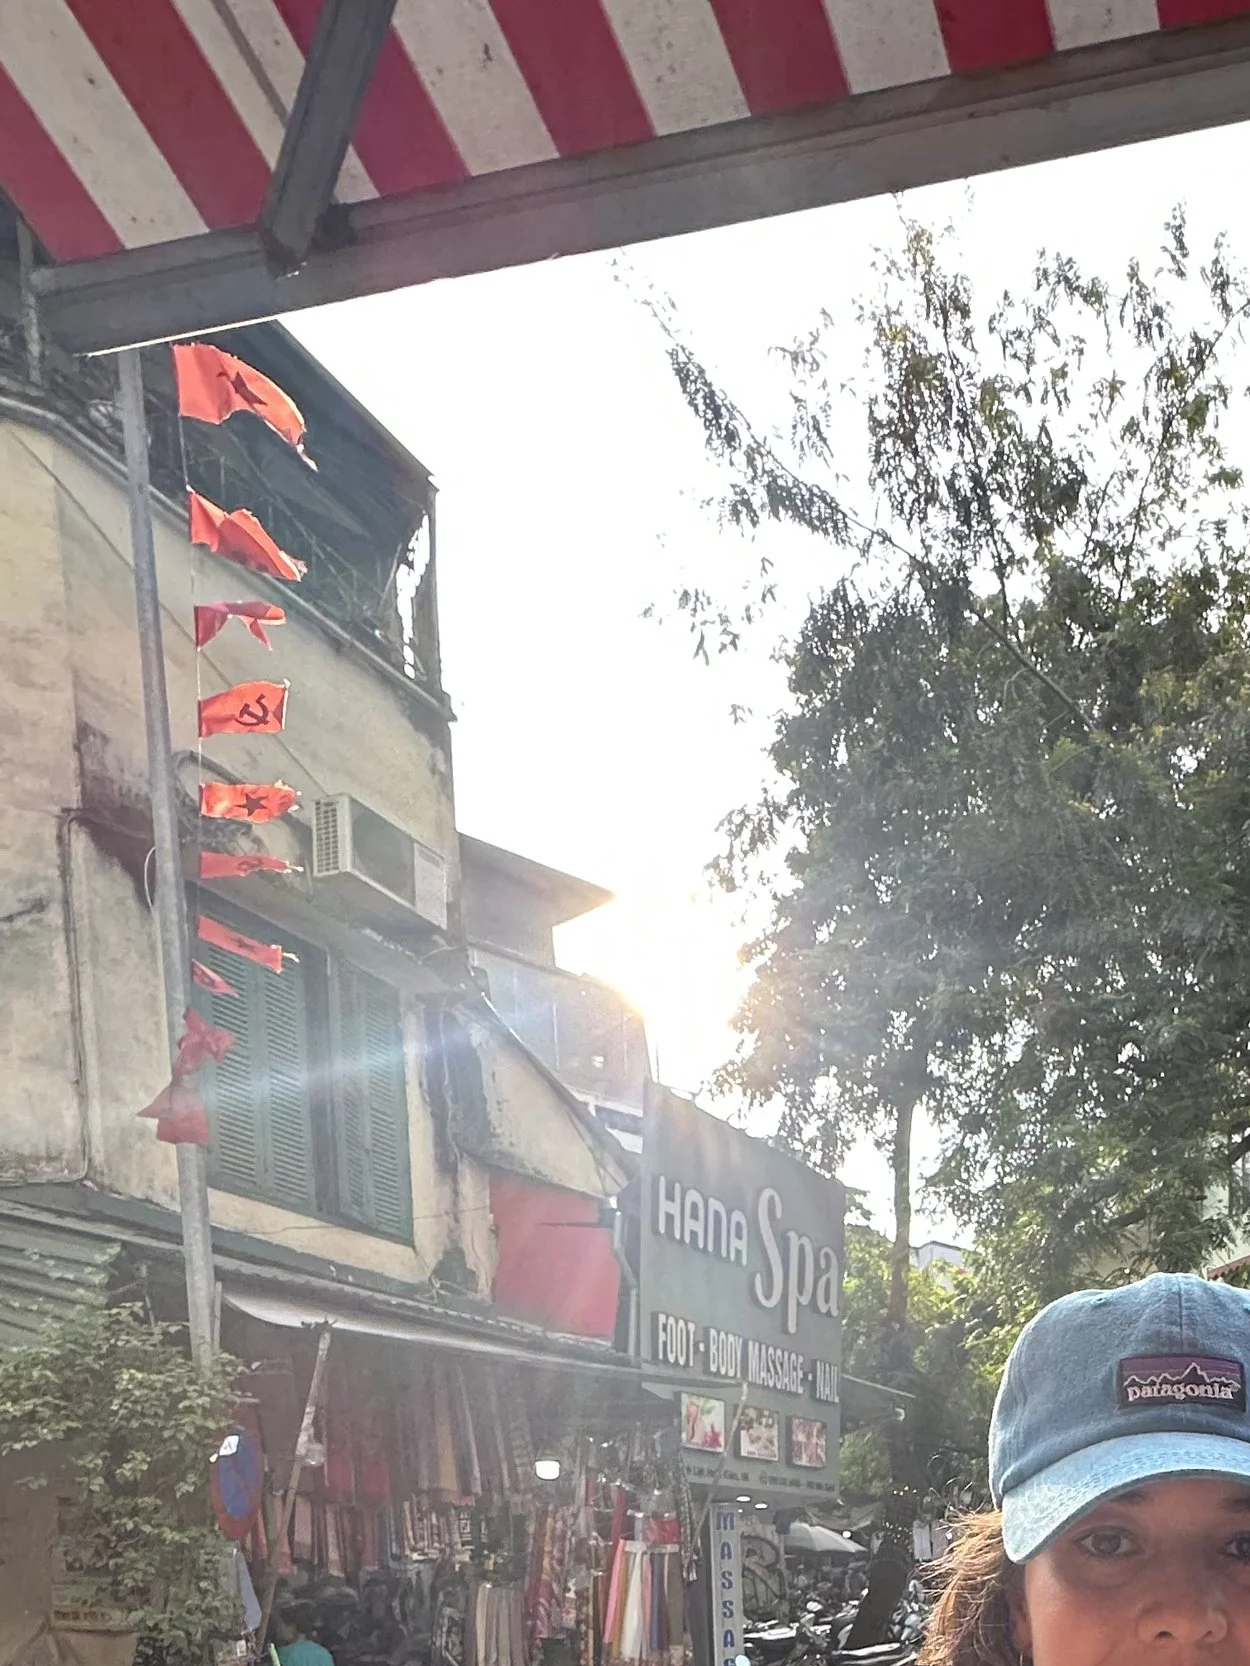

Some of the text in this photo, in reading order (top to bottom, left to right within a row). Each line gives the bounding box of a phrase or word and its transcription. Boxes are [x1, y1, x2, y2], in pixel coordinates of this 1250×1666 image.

[658, 1175, 840, 1334] HANA Spa
[657, 1312, 840, 1404] FOOT BODY MASSAGE NAIL
[1127, 1381, 1233, 1402] patagonia
